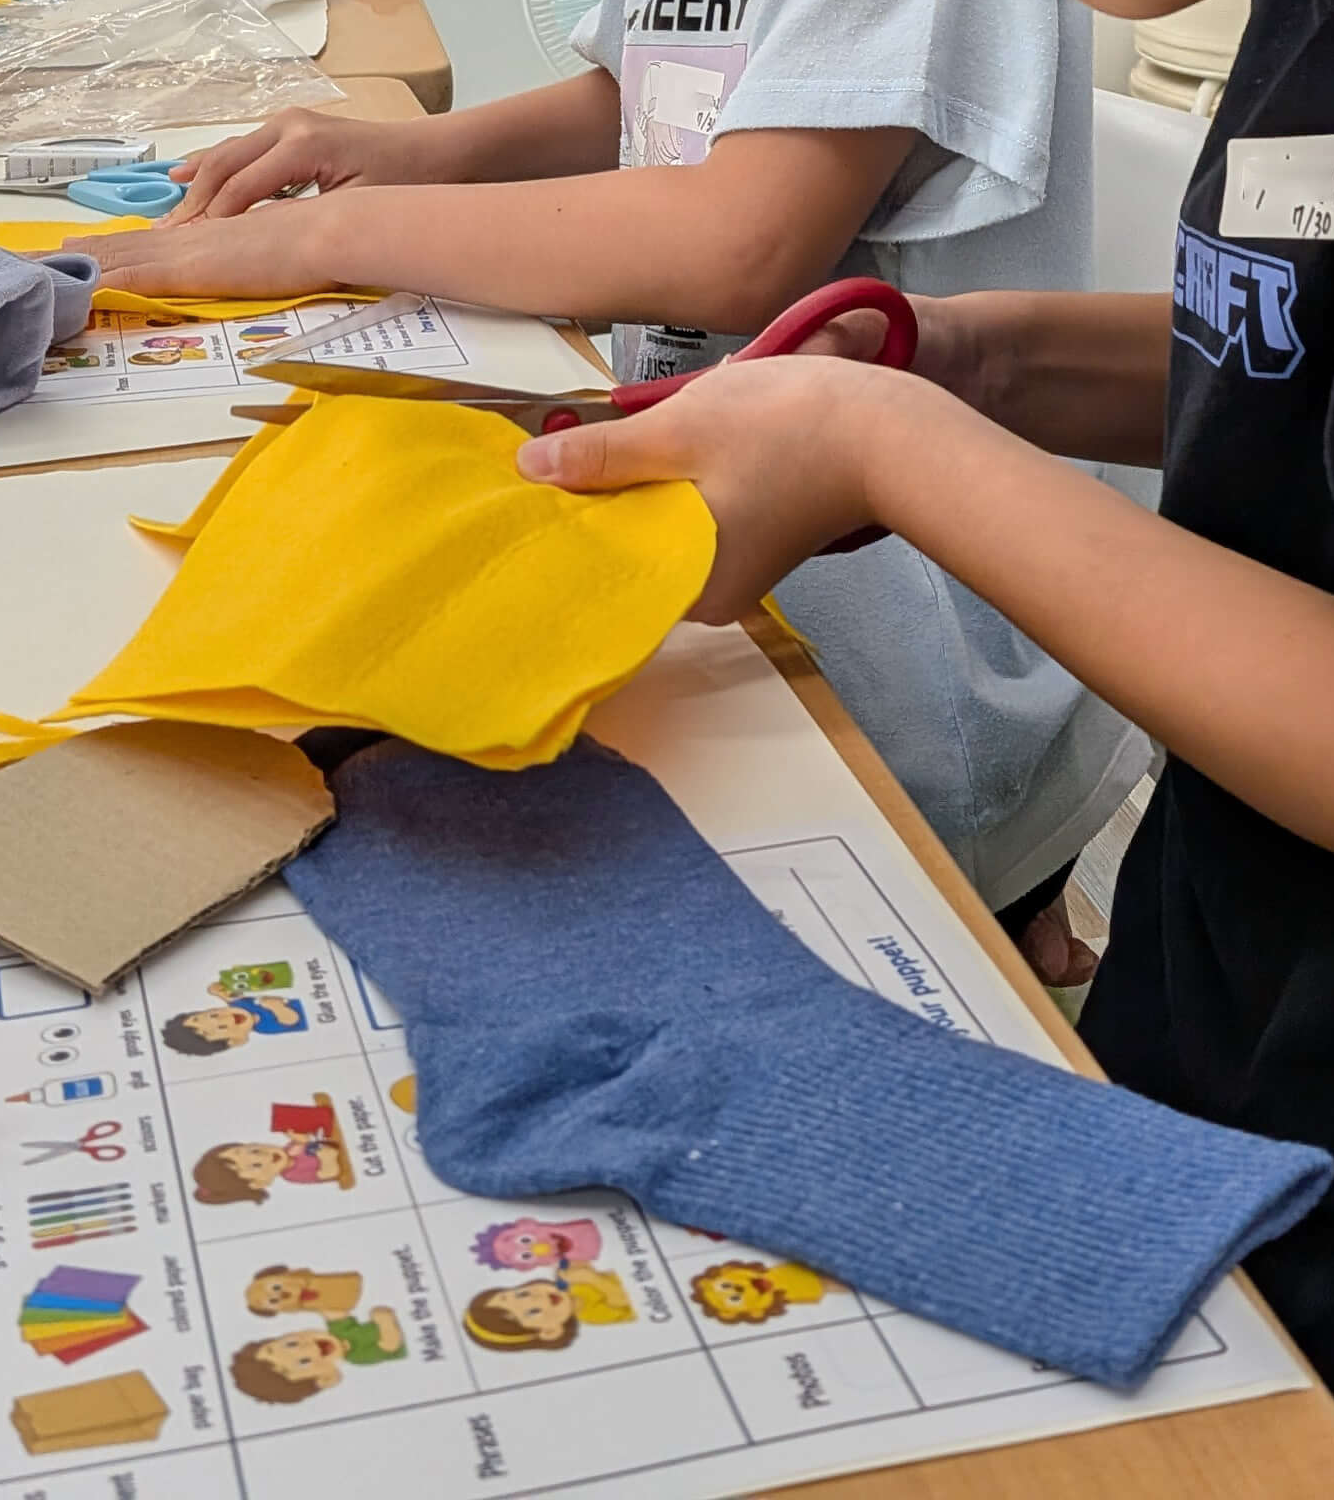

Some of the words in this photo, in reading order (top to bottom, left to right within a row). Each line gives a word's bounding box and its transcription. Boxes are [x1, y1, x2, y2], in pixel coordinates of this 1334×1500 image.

[1292, 204, 1332, 237] 7/30
[867, 935, 942, 997] puppet!
[313, 979, 329, 996] the
[119, 1009, 137, 1029] eyes
[318, 998, 337, 1025] Glue
[921, 1002, 970, 1035] our
[124, 1030, 144, 1058] googly
[130, 1070, 150, 1089] glue
[138, 1115, 158, 1153] scissors
[358, 1130, 375, 1153] the
[364, 1154, 385, 1177] Cut
[149, 1182, 168, 1224] markers
[163, 1255, 187, 1290] paper
[630, 1258, 654, 1284] the
[168, 1290, 192, 1333] colored
[411, 1297, 430, 1324] the
[639, 1282, 673, 1325] Color
[421, 1324, 445, 1364] Make
[183, 1365, 206, 1389] bag
[786, 1352, 830, 1410] Photos
[193, 1390, 213, 1429] paper
[469, 1414, 507, 1480] Phrases
